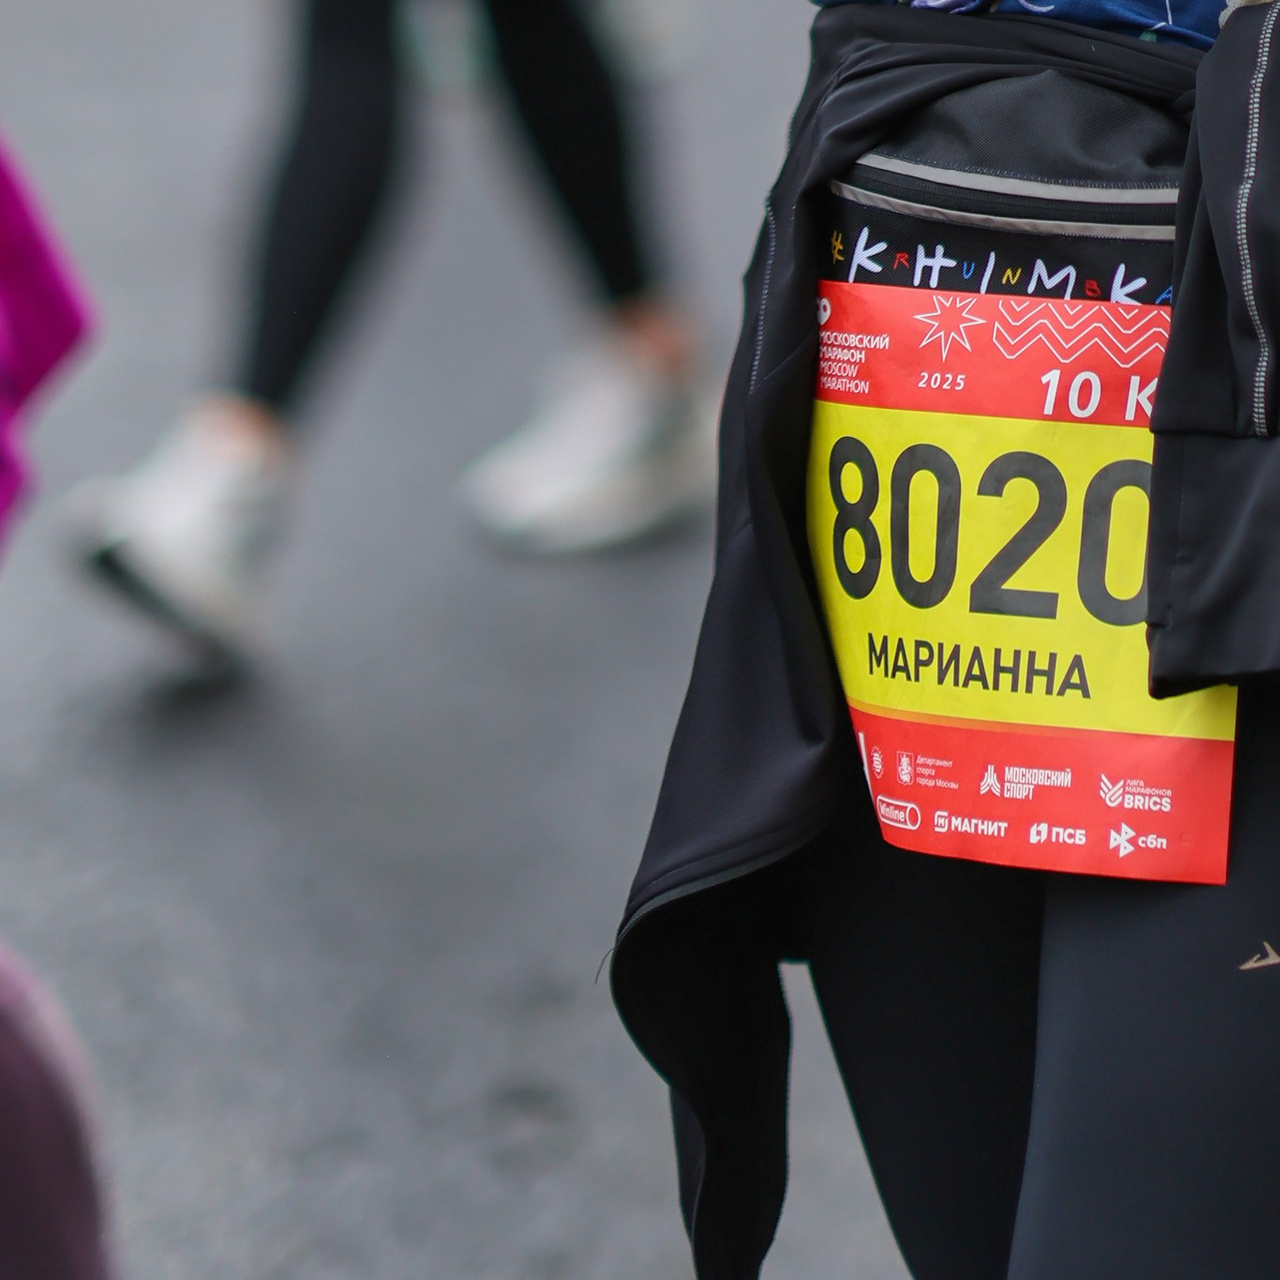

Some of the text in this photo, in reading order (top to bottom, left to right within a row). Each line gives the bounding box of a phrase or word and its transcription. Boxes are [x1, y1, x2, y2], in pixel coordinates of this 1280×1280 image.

[819, 331, 890, 350] МОСКОВСКИЙ
[819, 346, 866, 363] МАРАФОН
[820, 361, 858, 378] MOSCOW
[821, 376, 869, 394] MARATHON
[918, 372, 966, 390] 2025
[1041, 368, 1102, 418] 10
[829, 436, 1154, 627] 8020
[867, 632, 1092, 700] МАРИАННА
[916, 755, 953, 768] Департамент
[916, 767, 935, 777] спорта
[1005, 766, 1072, 788] МОСКОВСКИЙ
[916, 777, 959, 790] города Москвы
[1004, 783, 1035, 800] СПОРТ
[1125, 779, 1145, 788] ЛИГА
[1125, 786, 1172, 797] МАРАФОНОВ
[1123, 796, 1171, 812] BRICS
[951, 816, 1009, 838] МАГНИТ
[1051, 826, 1087, 845] ПСБ
[1137, 834, 1167, 850] сбп
